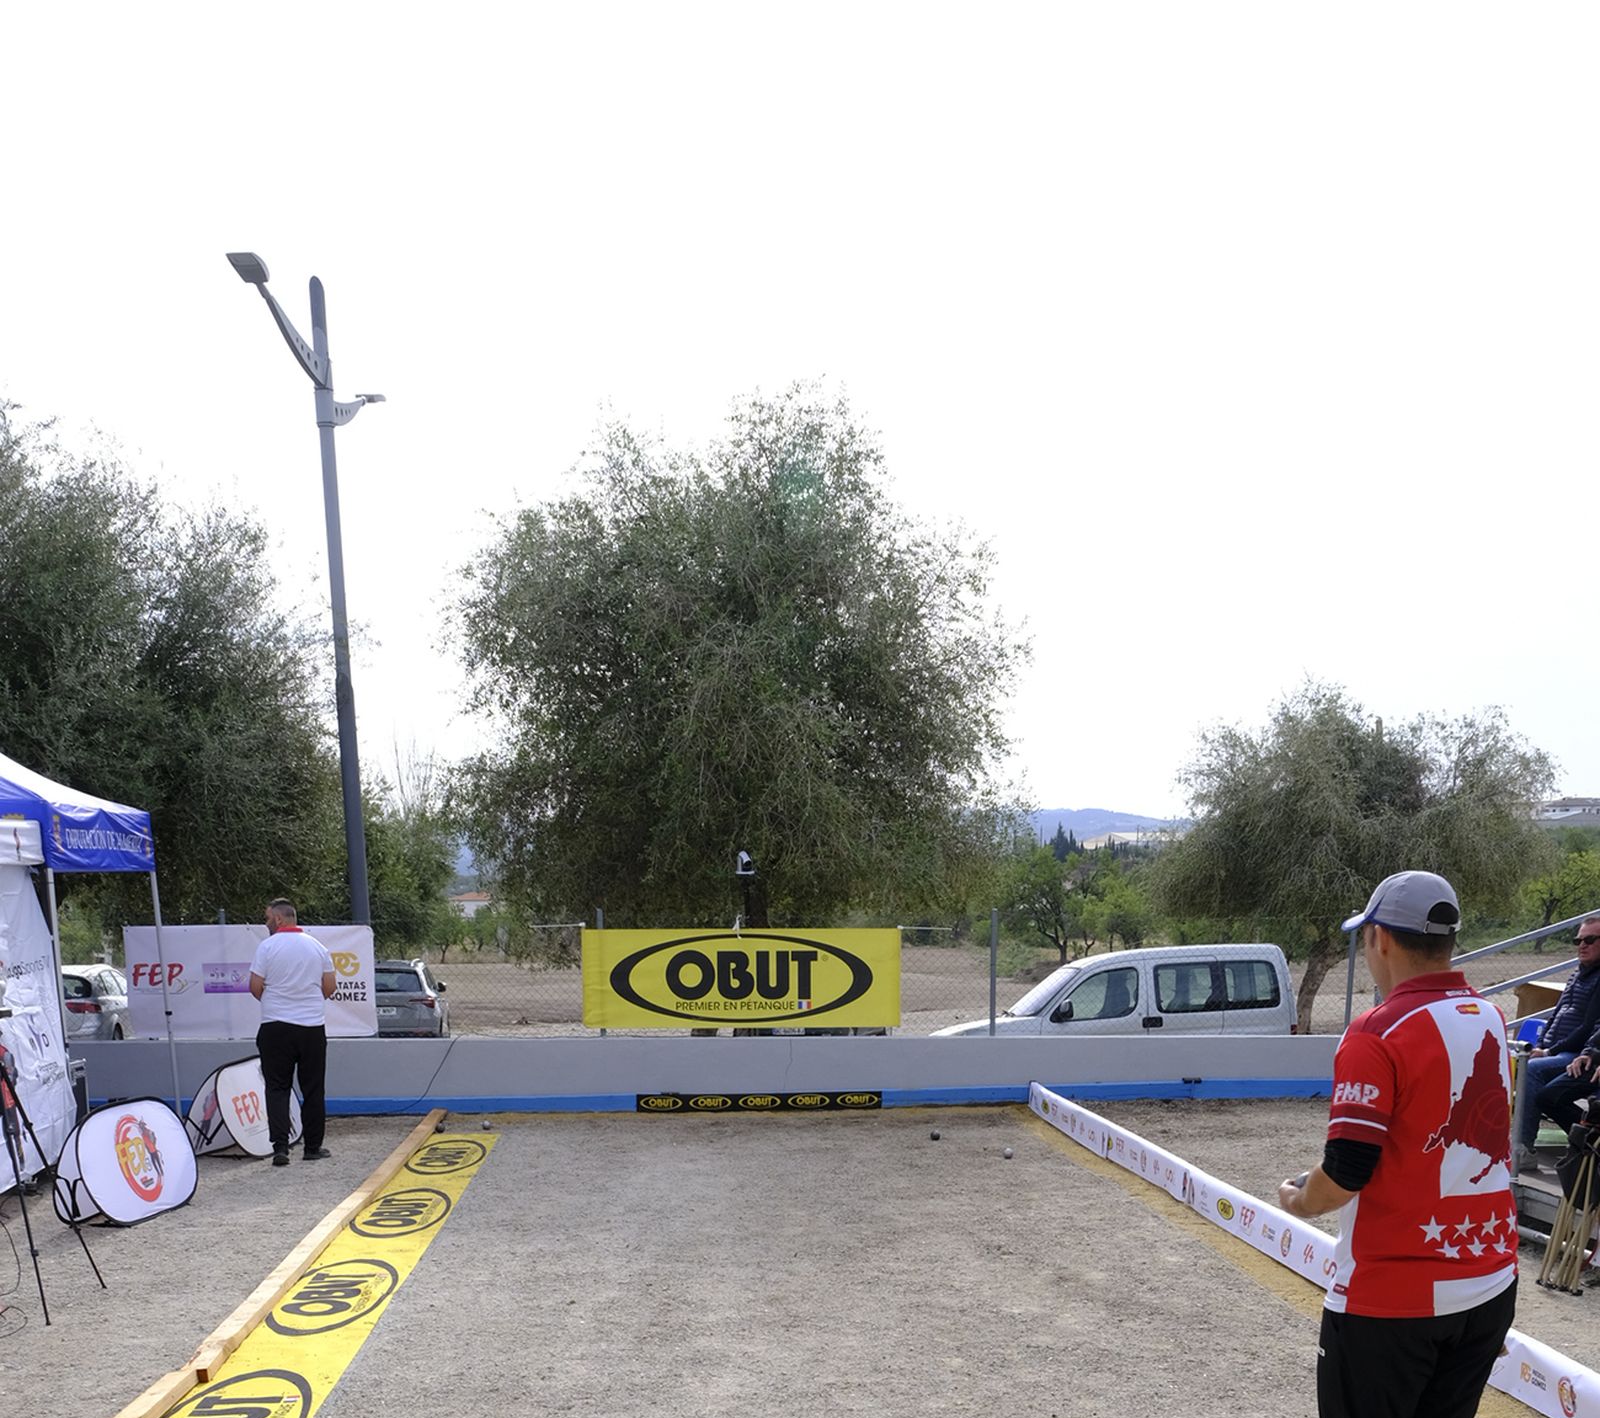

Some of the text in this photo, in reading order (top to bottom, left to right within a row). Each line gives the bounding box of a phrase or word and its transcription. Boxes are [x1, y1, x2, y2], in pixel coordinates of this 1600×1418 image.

[132, 963, 184, 987] FEP
[666, 949, 818, 1001] OBUT
[336, 981, 366, 990] TATAS
[675, 999, 795, 1011] PREMIER EN PÉTANQUE
[649, 1098, 673, 1108] OBUT
[698, 1098, 723, 1108] OBUT
[747, 1097, 772, 1107] OBUT
[796, 1096, 821, 1106] OBUT
[845, 1095, 870, 1105] OBUT
[1334, 1083, 1380, 1107] FMP
[232, 1090, 261, 1127] FEP
[414, 1147, 471, 1167] OBUT
[361, 1197, 433, 1228] OBUT
[280, 1273, 377, 1316] OBUT
